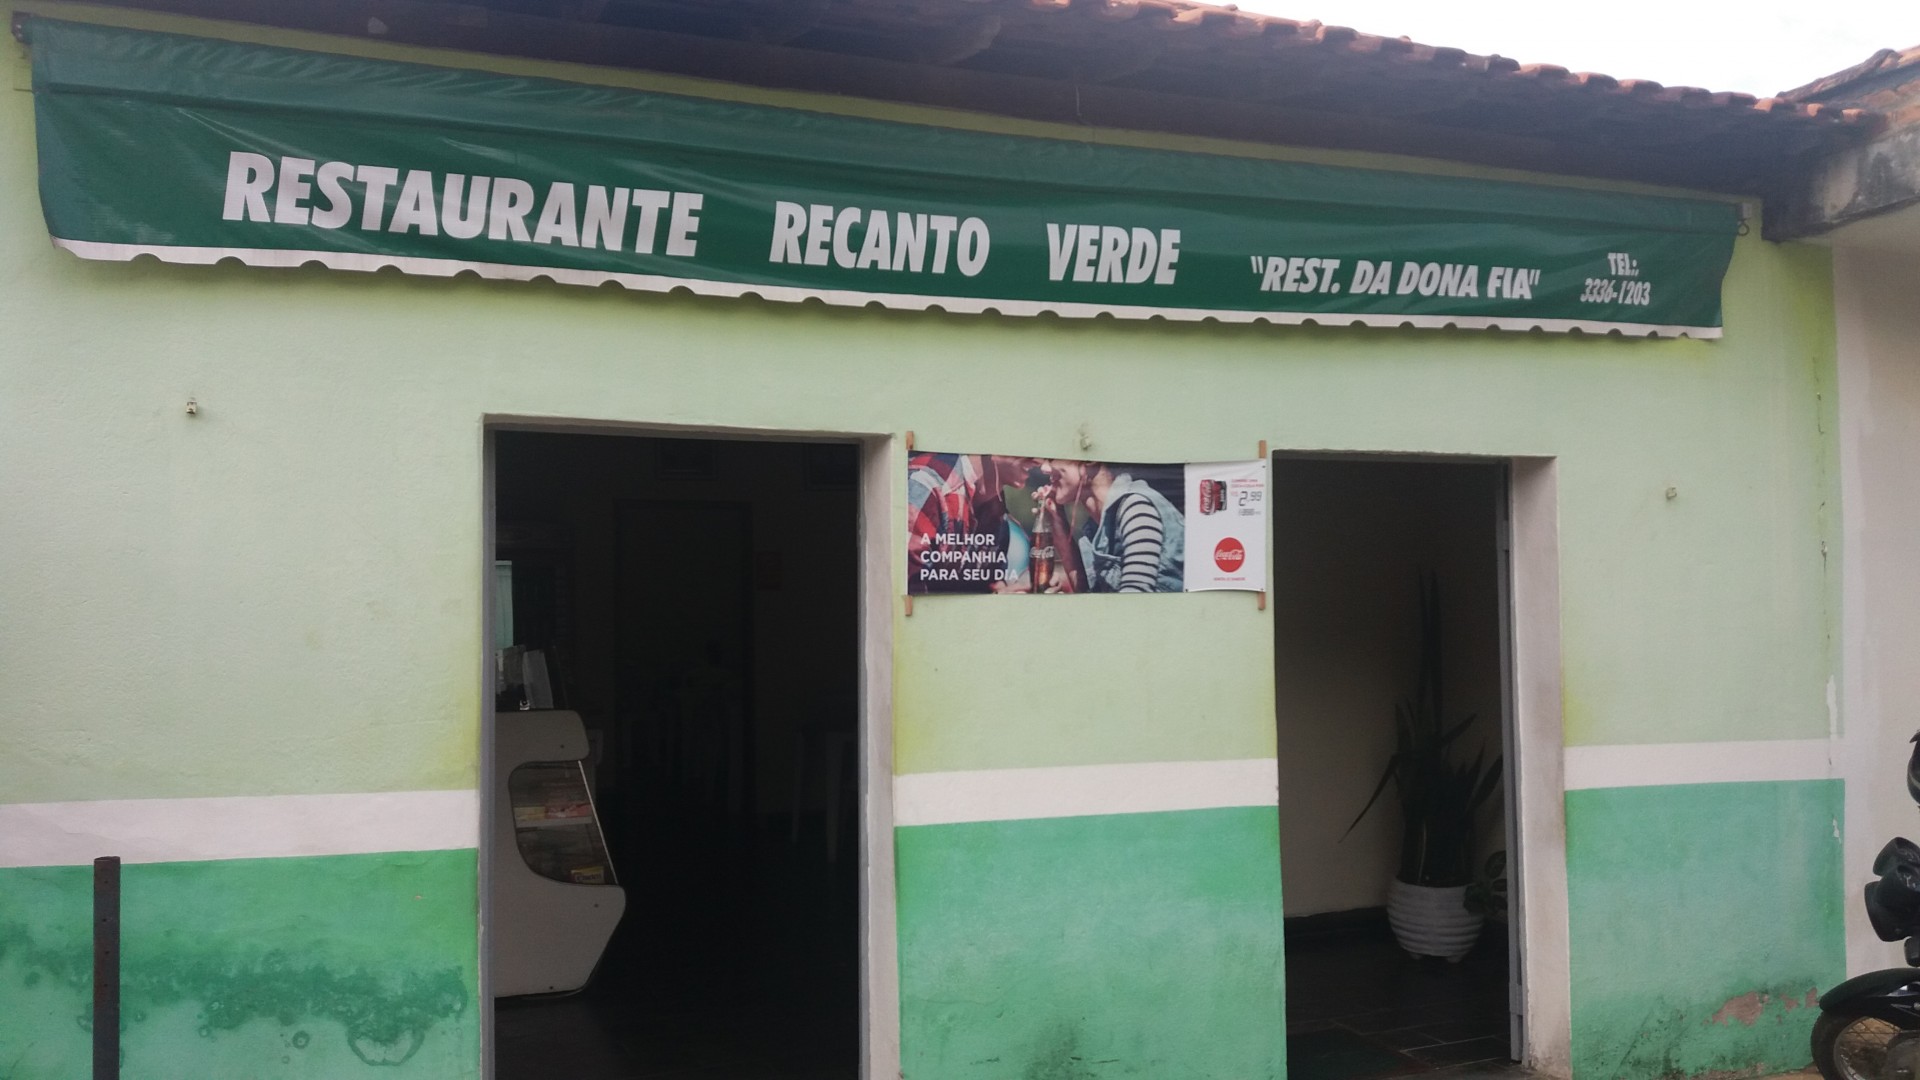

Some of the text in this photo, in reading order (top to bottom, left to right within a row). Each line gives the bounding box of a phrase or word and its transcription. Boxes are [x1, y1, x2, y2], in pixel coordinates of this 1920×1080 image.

[222, 151, 1181, 285] RESTAURANTE RECANTO VERDE
[1250, 255, 1541, 300] "REST. DA DONA FIA"
[1580, 277, 1651, 306] 3336-1203
[920, 533, 995, 546] A MELHOR
[920, 550, 1007, 563] COMPANHIA
[920, 568, 1018, 581] PARA SEU DIA
